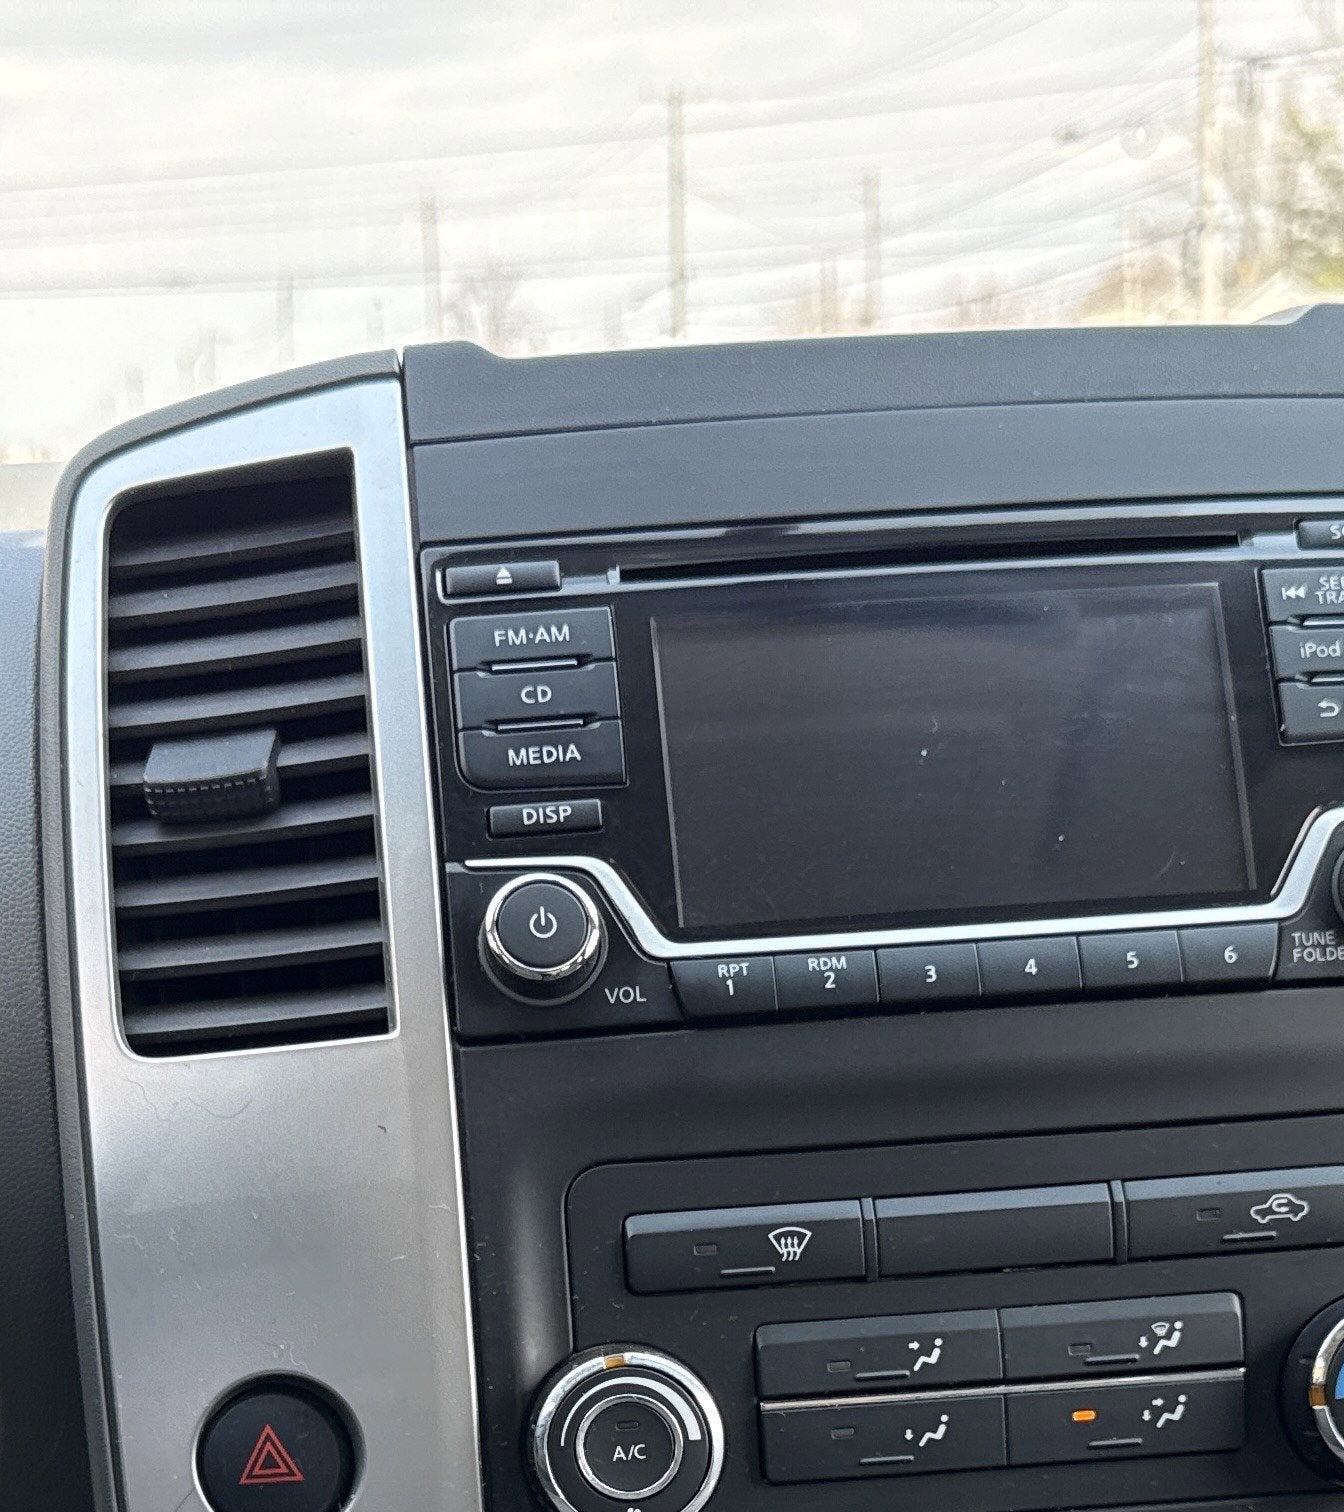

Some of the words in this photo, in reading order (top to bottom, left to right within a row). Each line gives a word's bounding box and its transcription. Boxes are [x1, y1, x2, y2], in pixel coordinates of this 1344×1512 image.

[1299, 641, 1341, 659] iPod
[520, 685, 553, 704] CD
[507, 744, 582, 768] MEDIA
[522, 806, 573, 827] DISP
[1291, 930, 1337, 947] TUNE
[1126, 950, 1140, 969] 5
[1223, 945, 1238, 964] 6
[717, 962, 750, 979] RPT
[807, 956, 848, 973] RDM
[1024, 957, 1039, 977] 4
[824, 971, 836, 990] 2
[925, 966, 938, 984] 3
[604, 985, 648, 1005] VOL
[725, 979, 735, 997] 1
[612, 1443, 647, 1462] A/C
